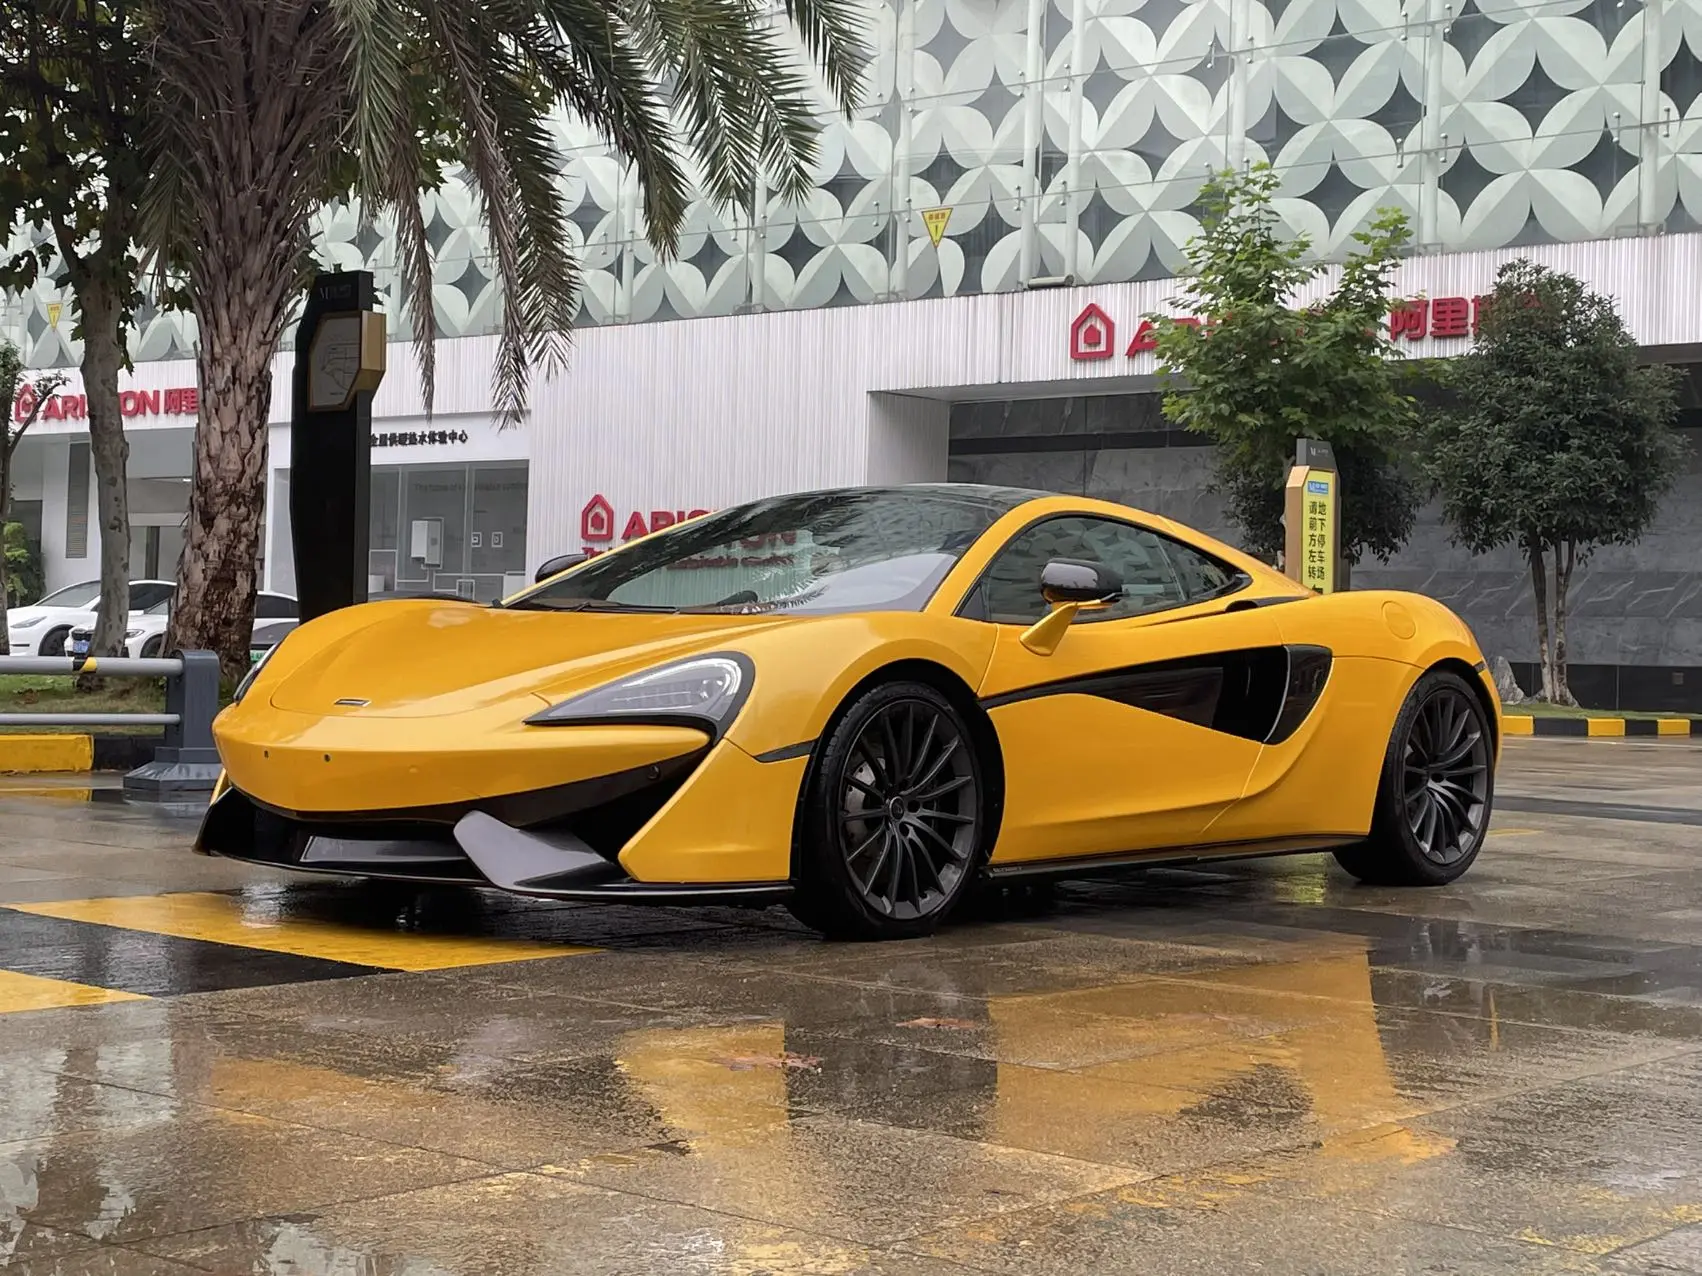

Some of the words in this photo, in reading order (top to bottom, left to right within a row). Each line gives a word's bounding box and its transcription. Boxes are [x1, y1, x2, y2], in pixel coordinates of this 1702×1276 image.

[1316, 500, 1327, 581] 地下停车场
